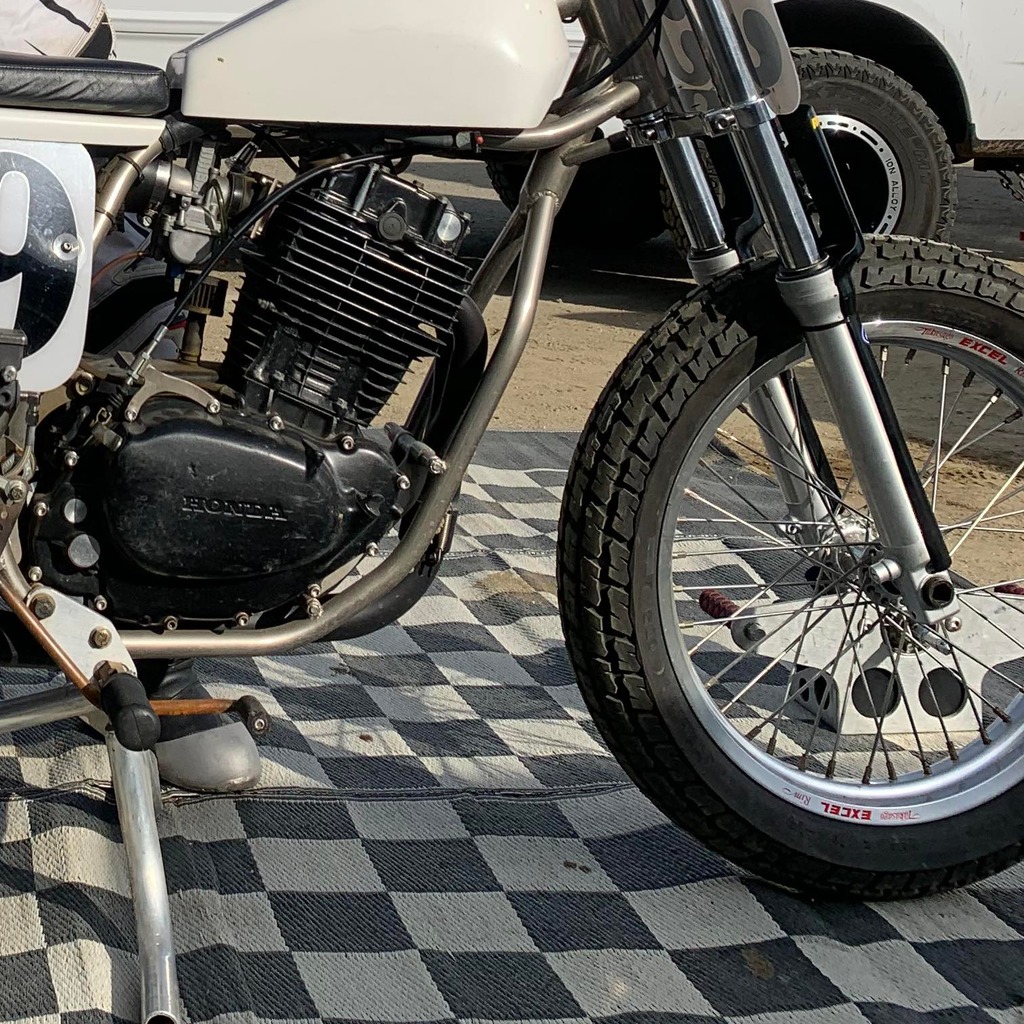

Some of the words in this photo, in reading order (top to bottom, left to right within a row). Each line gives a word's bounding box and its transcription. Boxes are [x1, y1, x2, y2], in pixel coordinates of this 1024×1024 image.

[885, 158, 896, 175] ION
[890, 180, 900, 212] ALLOY
[959, 337, 1008, 365] EXCEL
[181, 496, 287, 521] HONDA
[794, 792, 811, 806] Rim
[821, 801, 872, 820] EXCEL
